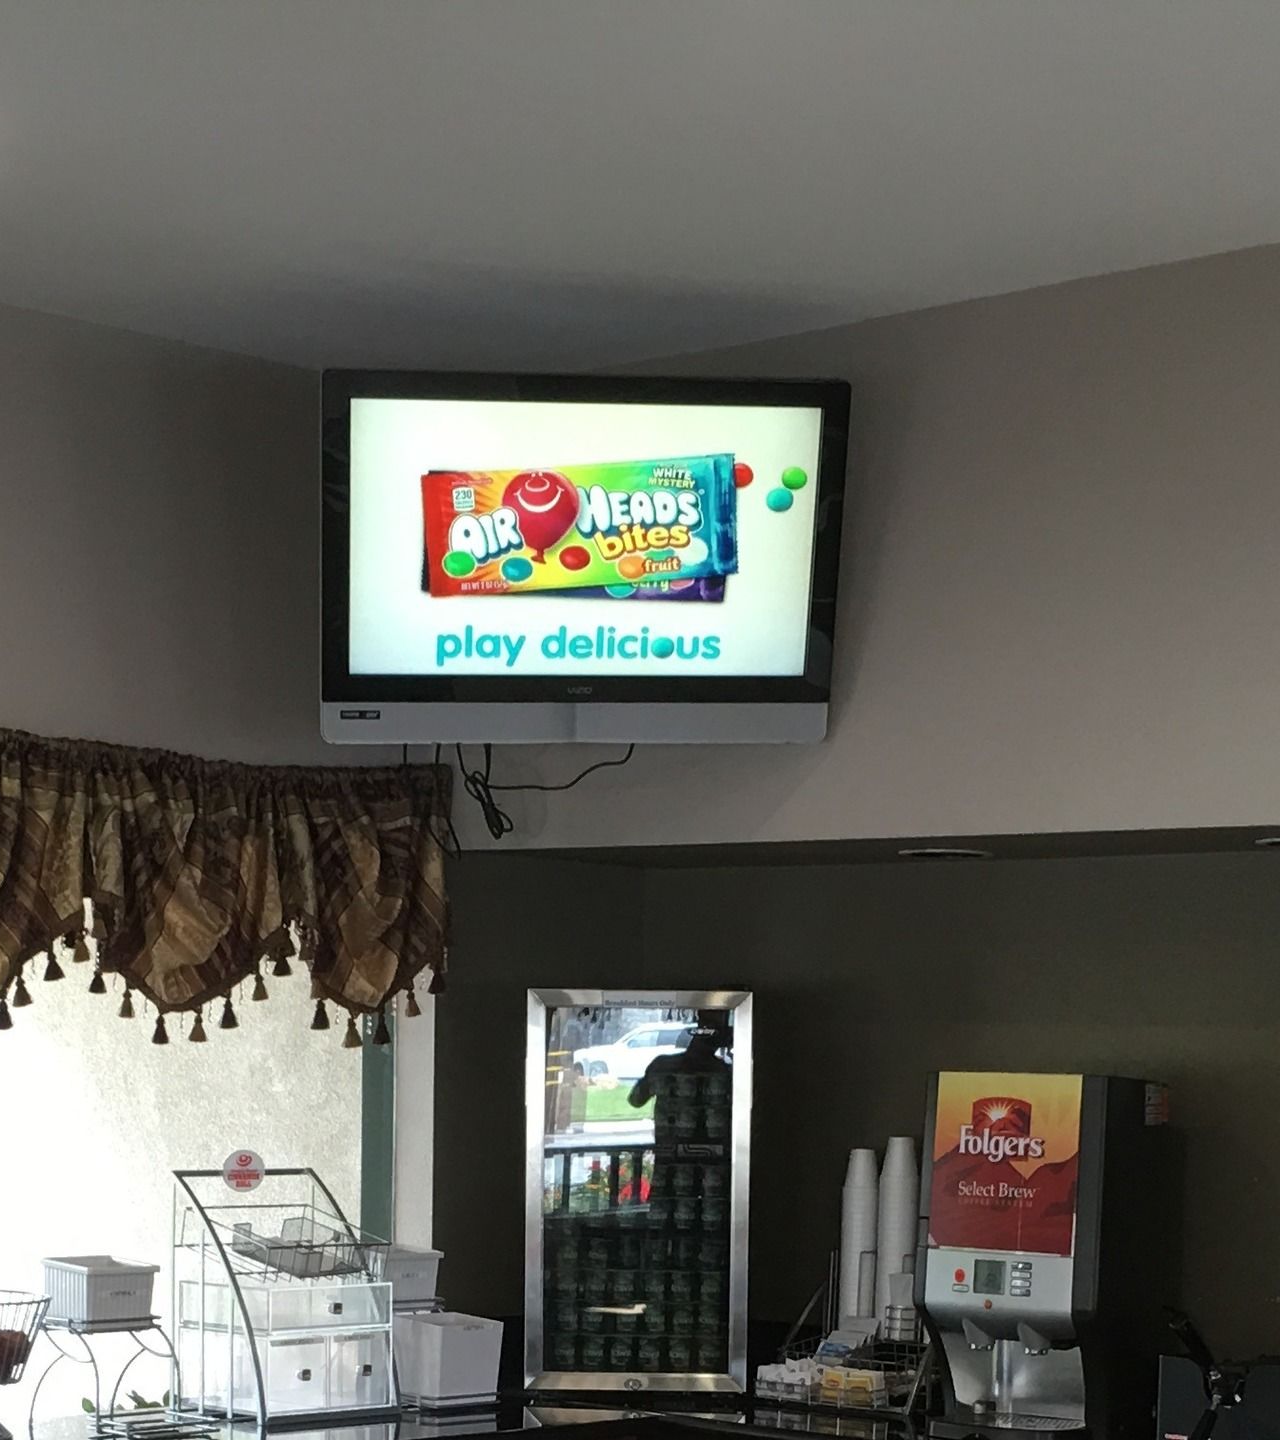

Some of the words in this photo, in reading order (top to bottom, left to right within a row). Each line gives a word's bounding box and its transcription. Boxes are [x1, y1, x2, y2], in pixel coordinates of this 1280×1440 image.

[648, 477, 696, 489] MYSTERY
[653, 468, 692, 478] WHITE
[455, 490, 473, 500] 230
[575, 484, 703, 538] HEADS
[451, 508, 524, 566] AIR
[593, 523, 691, 561] bites
[642, 558, 681, 573] fruit
[436, 624, 526, 667] play
[540, 625, 722, 659] delicious
[958, 1125, 1044, 1163] Folgers
[958, 1180, 996, 1197] Select
[998, 1182, 1037, 1199] Brew
